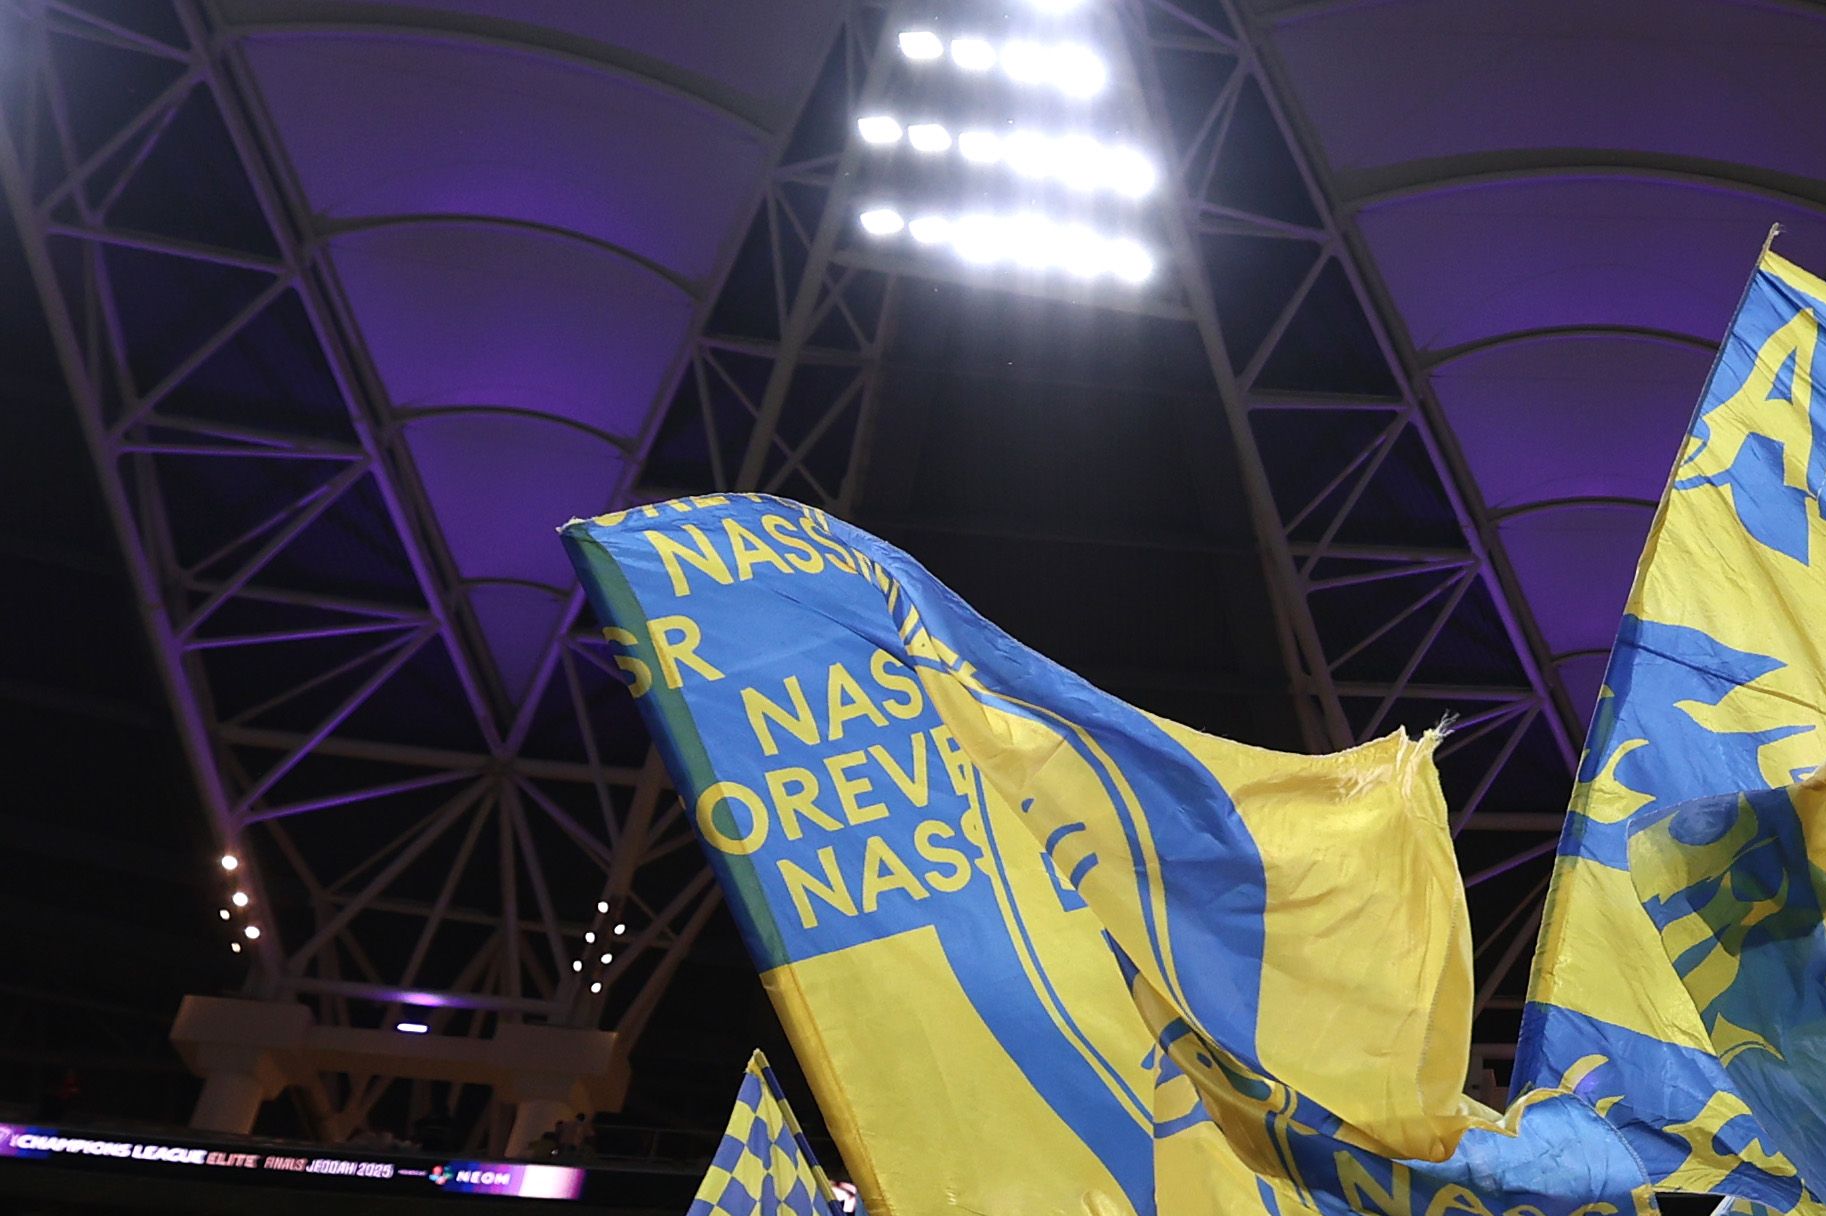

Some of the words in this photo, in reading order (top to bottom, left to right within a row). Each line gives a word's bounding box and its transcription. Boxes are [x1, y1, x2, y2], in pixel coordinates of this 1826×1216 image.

[644, 513, 862, 598] NASS
[739, 648, 924, 757] NAS
[16, 1133, 133, 1158] CHAMPIONS
[131, 1143, 207, 1165] LEAGUE
[205, 1150, 260, 1168] ELITE
[456, 1169, 511, 1186] NEOM
